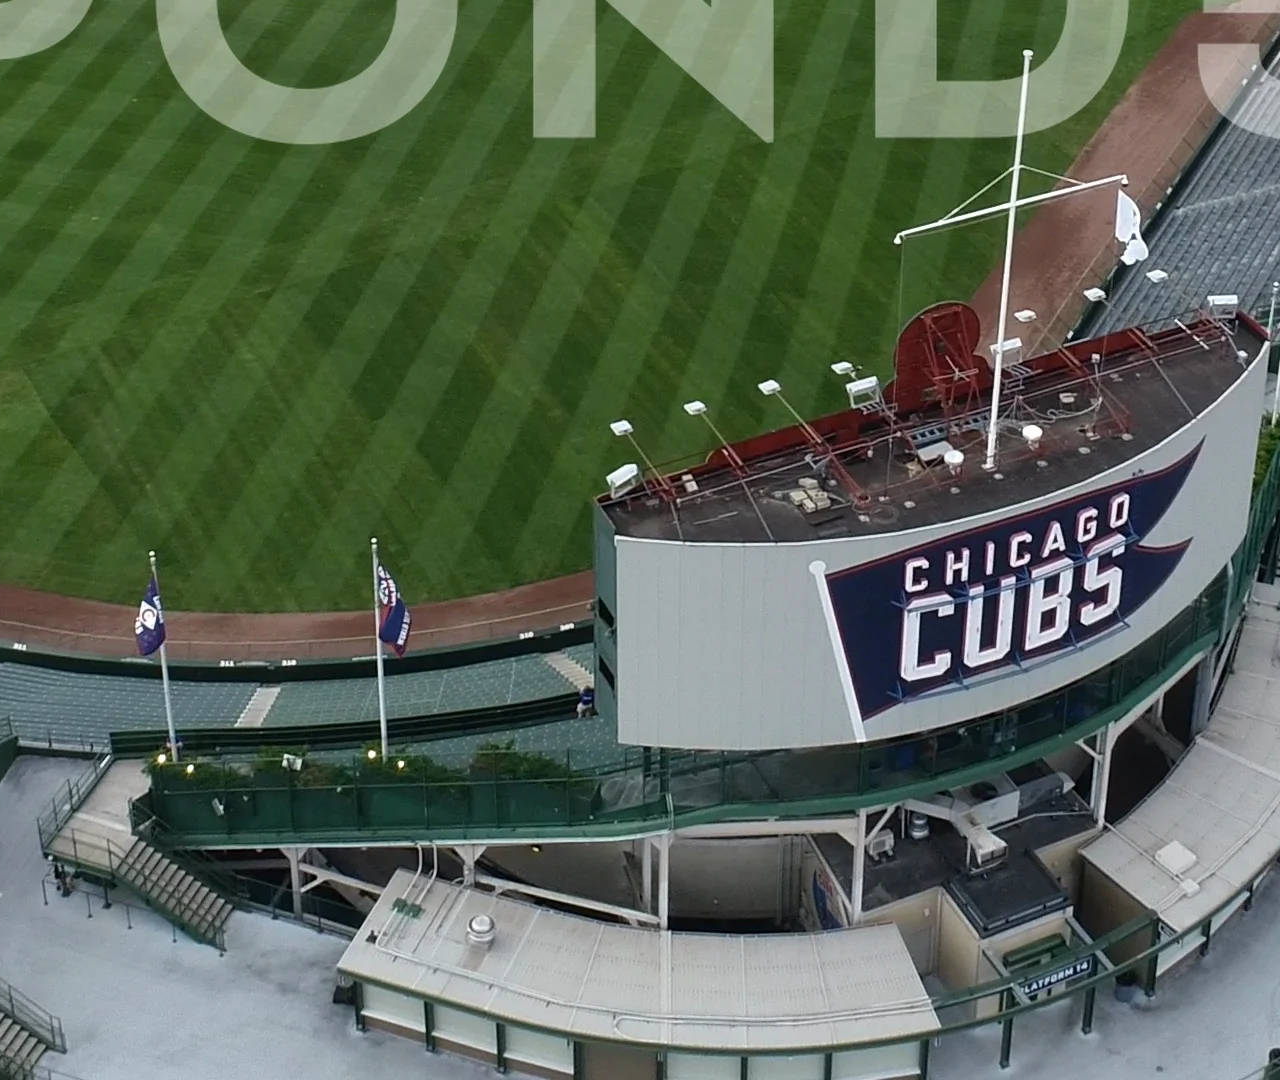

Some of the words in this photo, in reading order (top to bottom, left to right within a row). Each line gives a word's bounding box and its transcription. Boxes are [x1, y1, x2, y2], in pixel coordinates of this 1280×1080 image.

[904, 492, 1131, 594] CHICAGO
[899, 533, 1127, 682] CUBS
[1075, 962, 1089, 974] 14
